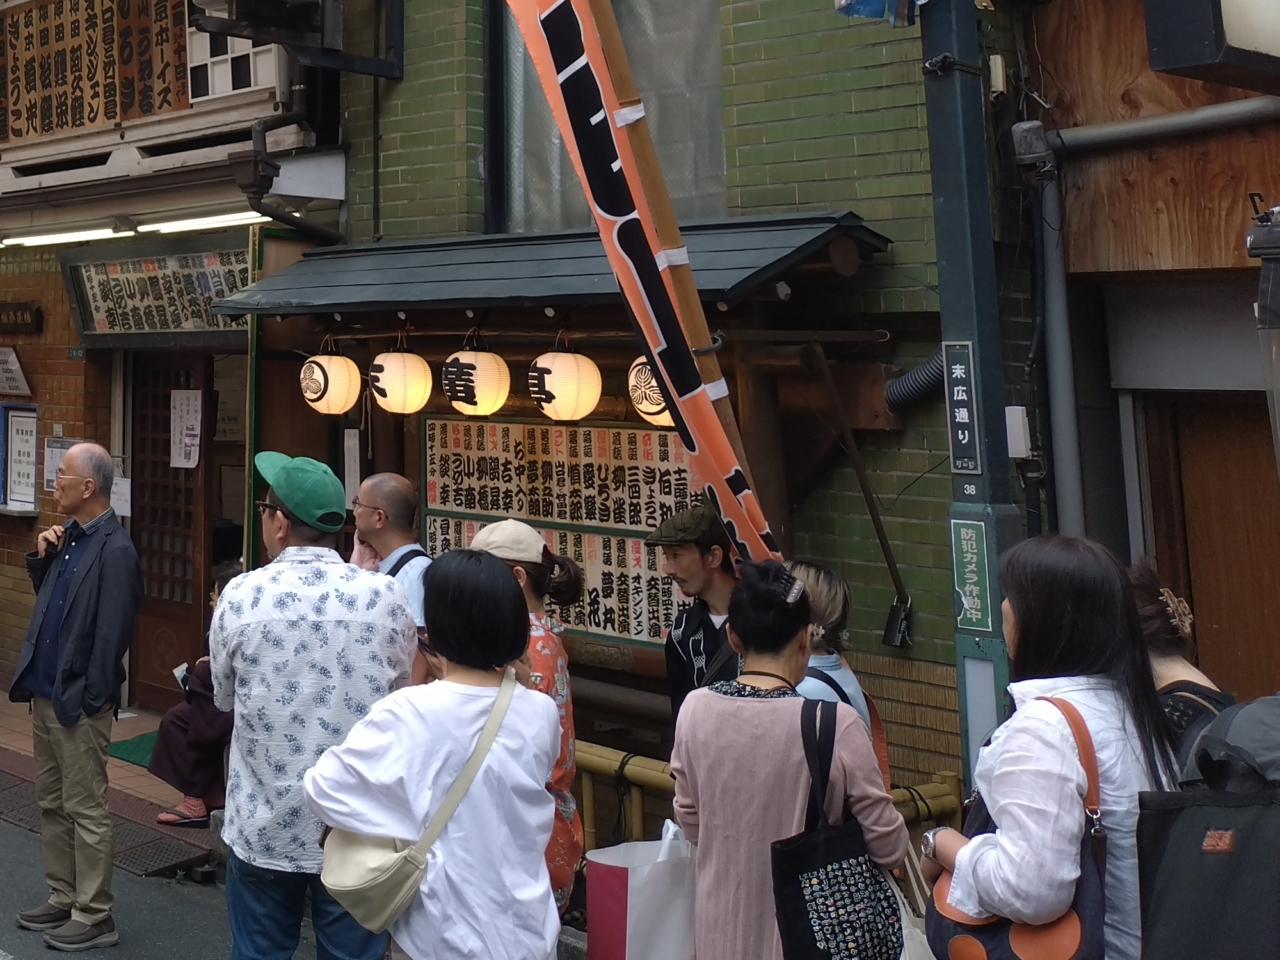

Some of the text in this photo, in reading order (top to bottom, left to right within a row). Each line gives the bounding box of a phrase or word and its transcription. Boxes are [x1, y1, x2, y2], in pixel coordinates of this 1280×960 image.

[951, 363, 971, 444] 末広通り
[451, 451, 464, 508] うめ吉
[463, 455, 477, 510] 小南
[501, 457, 514, 514] 吉幸
[963, 484, 977, 496] 38
[960, 527, 982, 623] 防犯カメラ作動中
[631, 572, 645, 636] オキシジェン
